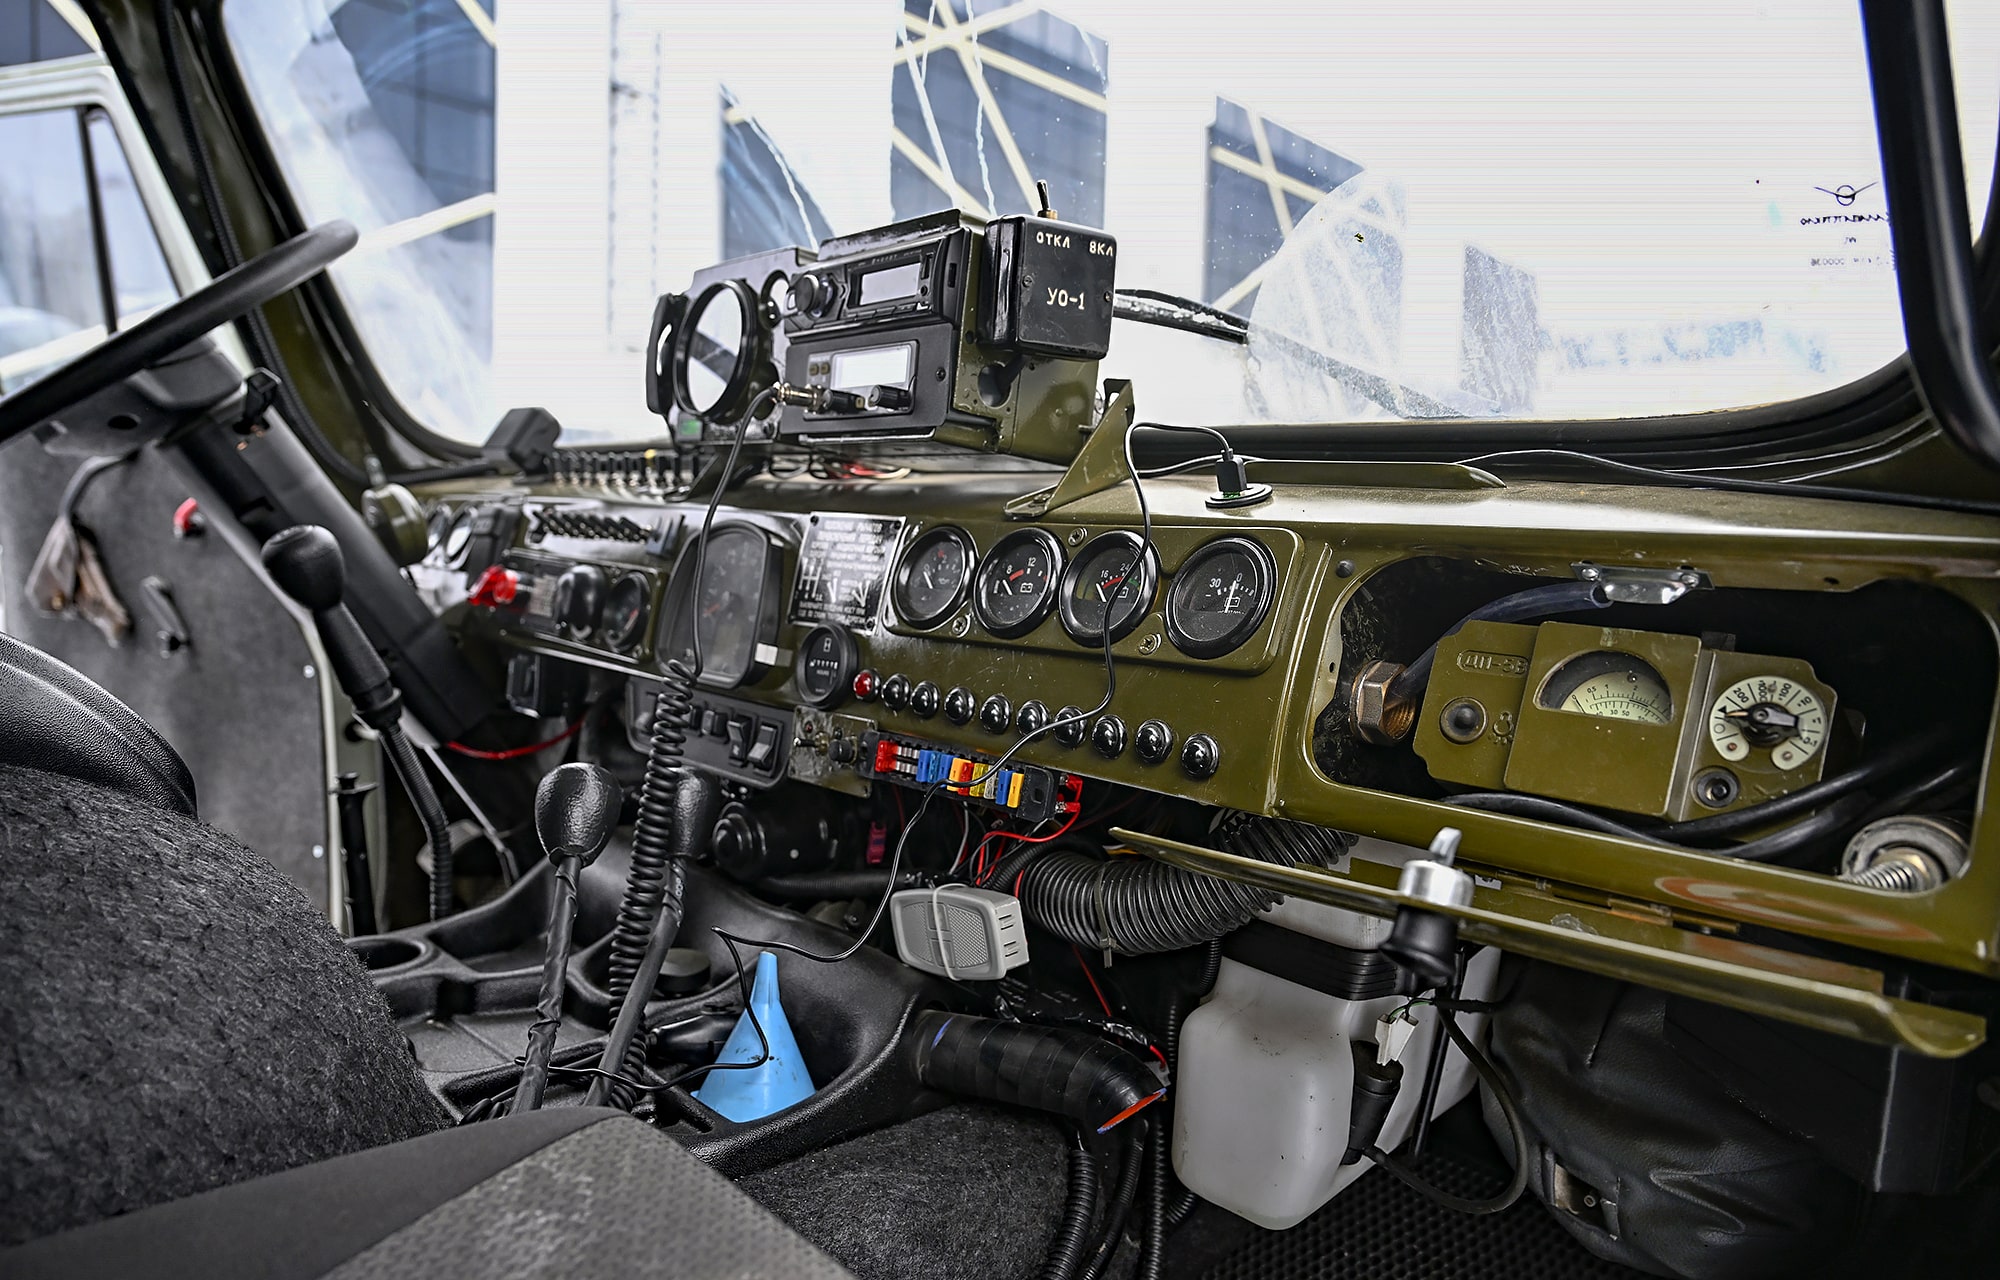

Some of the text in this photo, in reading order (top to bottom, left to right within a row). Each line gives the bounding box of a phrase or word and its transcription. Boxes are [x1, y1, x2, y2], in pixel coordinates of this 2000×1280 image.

[1036, 231, 1070, 249] ОТКЛ
[1046, 287, 1085, 310] УО-1
[1027, 556, 1037, 567] 12
[1006, 564, 1013, 575] 8
[1100, 569, 1110, 579] 16
[1209, 577, 1222, 588] 30
[1236, 572, 1243, 582] 0
[1732, 687, 1750, 704] 200
